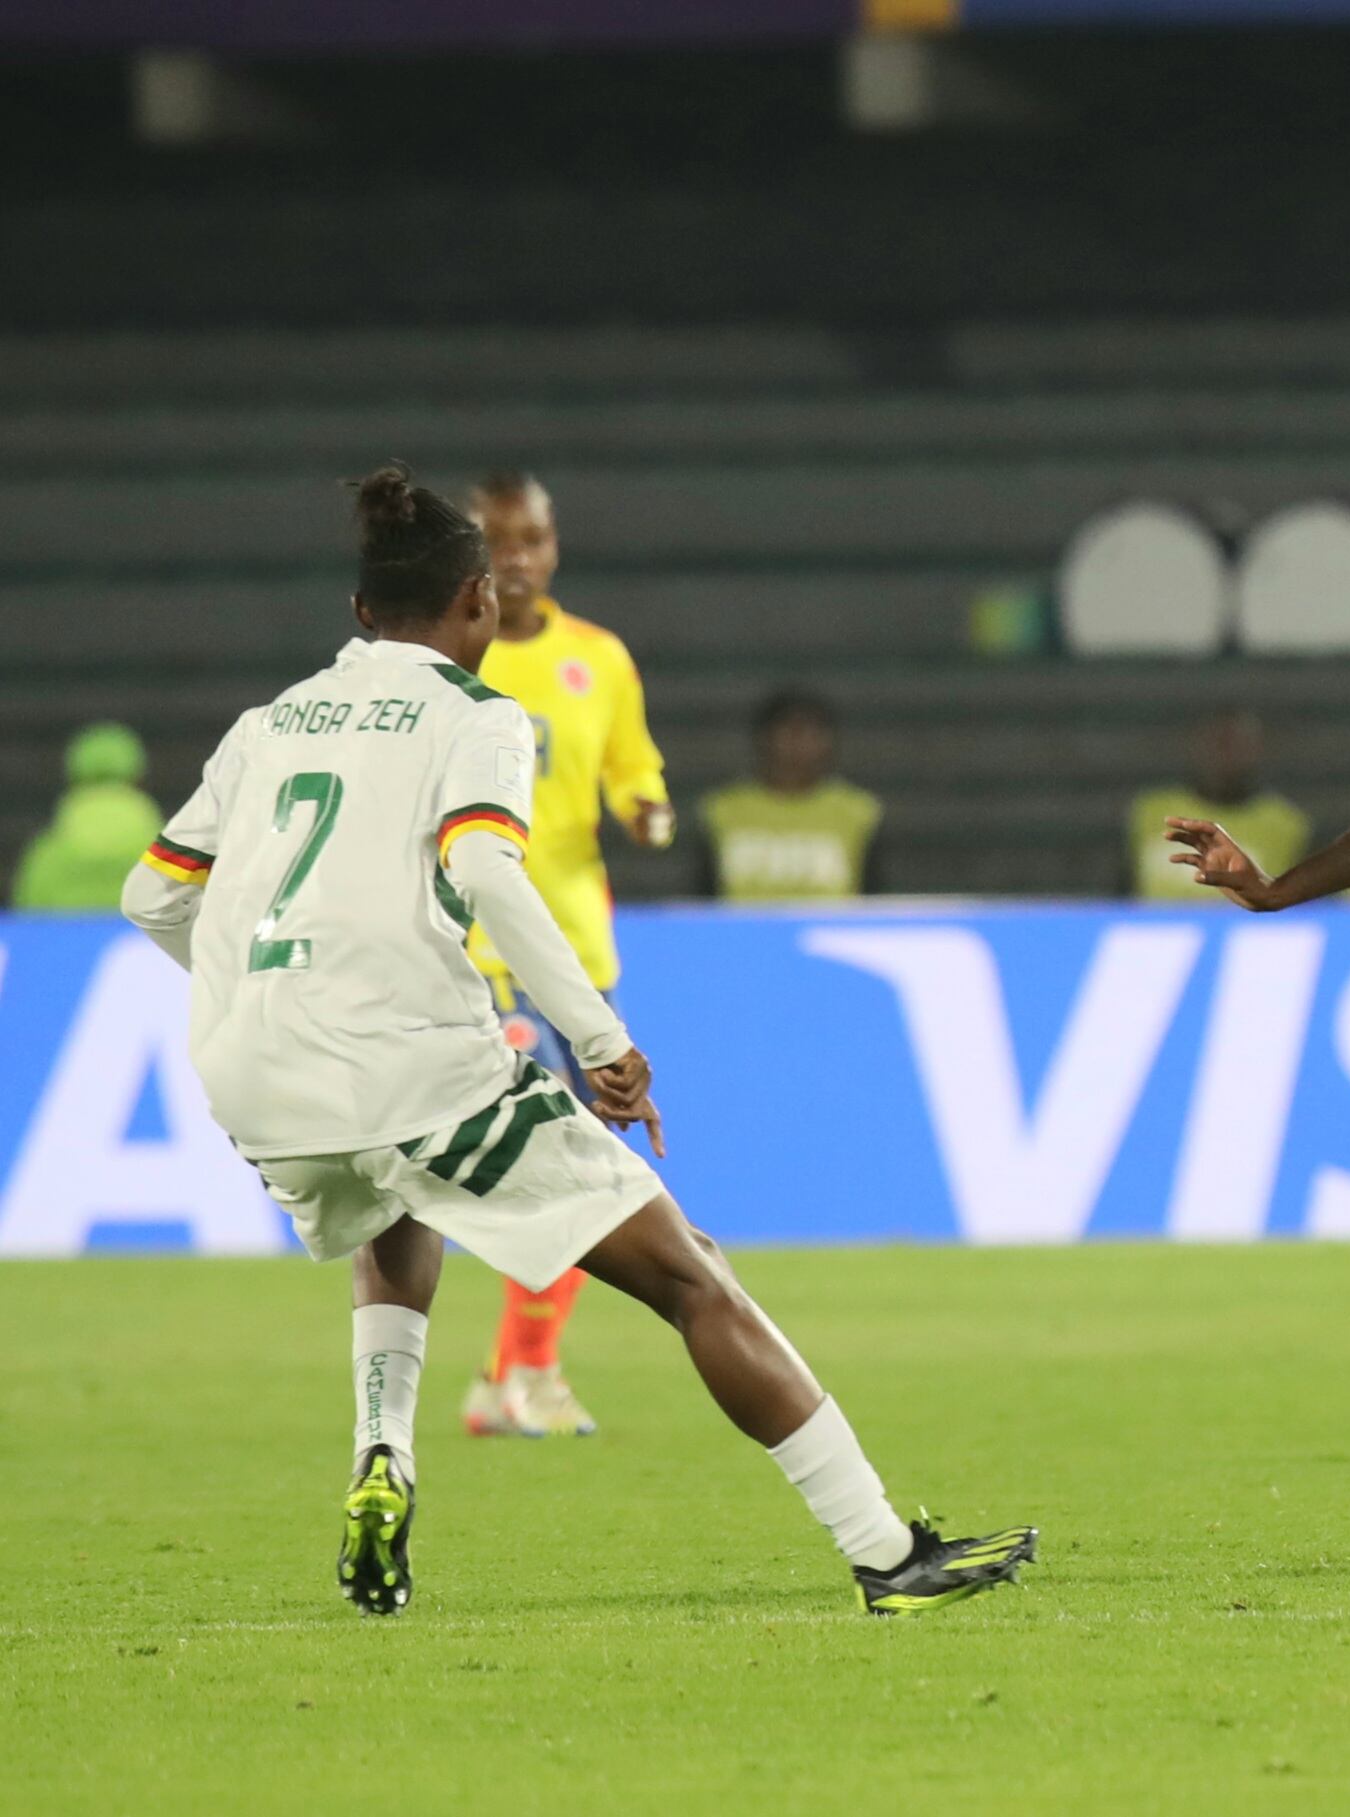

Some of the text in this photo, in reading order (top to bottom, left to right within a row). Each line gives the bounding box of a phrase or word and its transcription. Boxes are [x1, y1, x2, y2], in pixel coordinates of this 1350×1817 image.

[356, 699, 427, 734] ZEH
[248, 771, 344, 974] 2
[0, 925, 292, 1257] A
